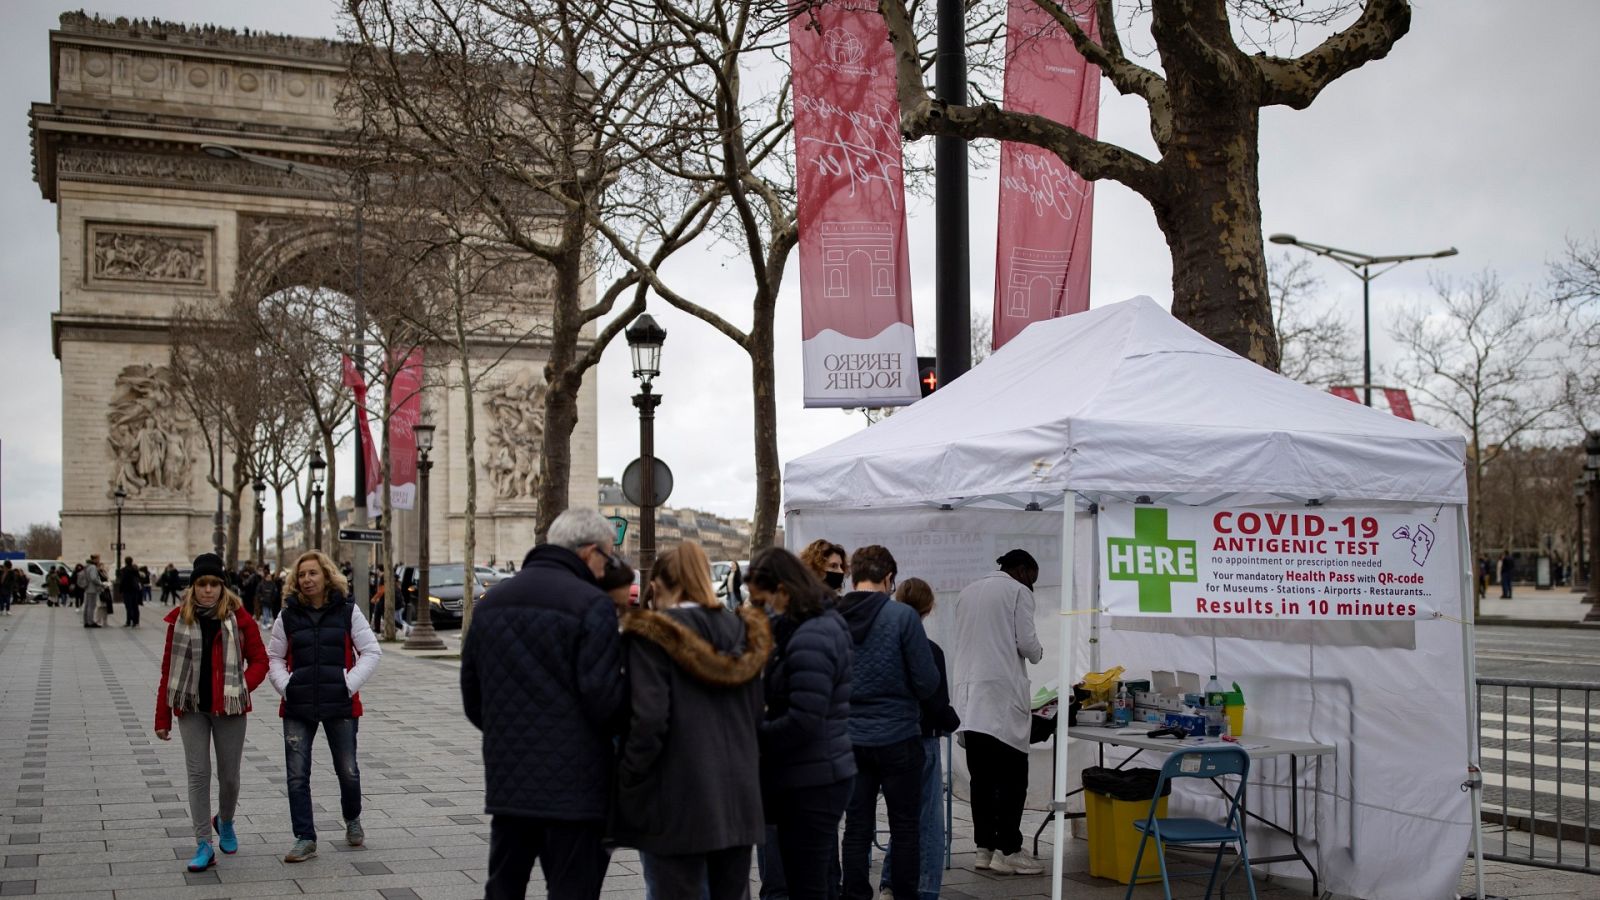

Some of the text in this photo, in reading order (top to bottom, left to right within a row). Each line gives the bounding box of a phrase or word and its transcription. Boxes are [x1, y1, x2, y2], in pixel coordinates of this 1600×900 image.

[1212, 511, 1379, 539] COVID-19
[1213, 537, 1380, 556] ANTIGENIC TEST
[1110, 544, 1195, 576] HERE
[1225, 556, 1283, 566] appointment
[1285, 558, 1295, 566] or
[1297, 558, 1349, 568] prescription
[1351, 559, 1382, 568] needed
[1212, 570, 1424, 585] Your mandatory Health Pass with QR-code
[1206, 583, 1220, 593] for
[1223, 584, 1268, 594] Museums
[1276, 585, 1315, 594] Stations
[1324, 586, 1362, 596] Airports
[1369, 587, 1432, 596] Restaurants...
[1196, 597, 1416, 616] Results in 10 minutes
